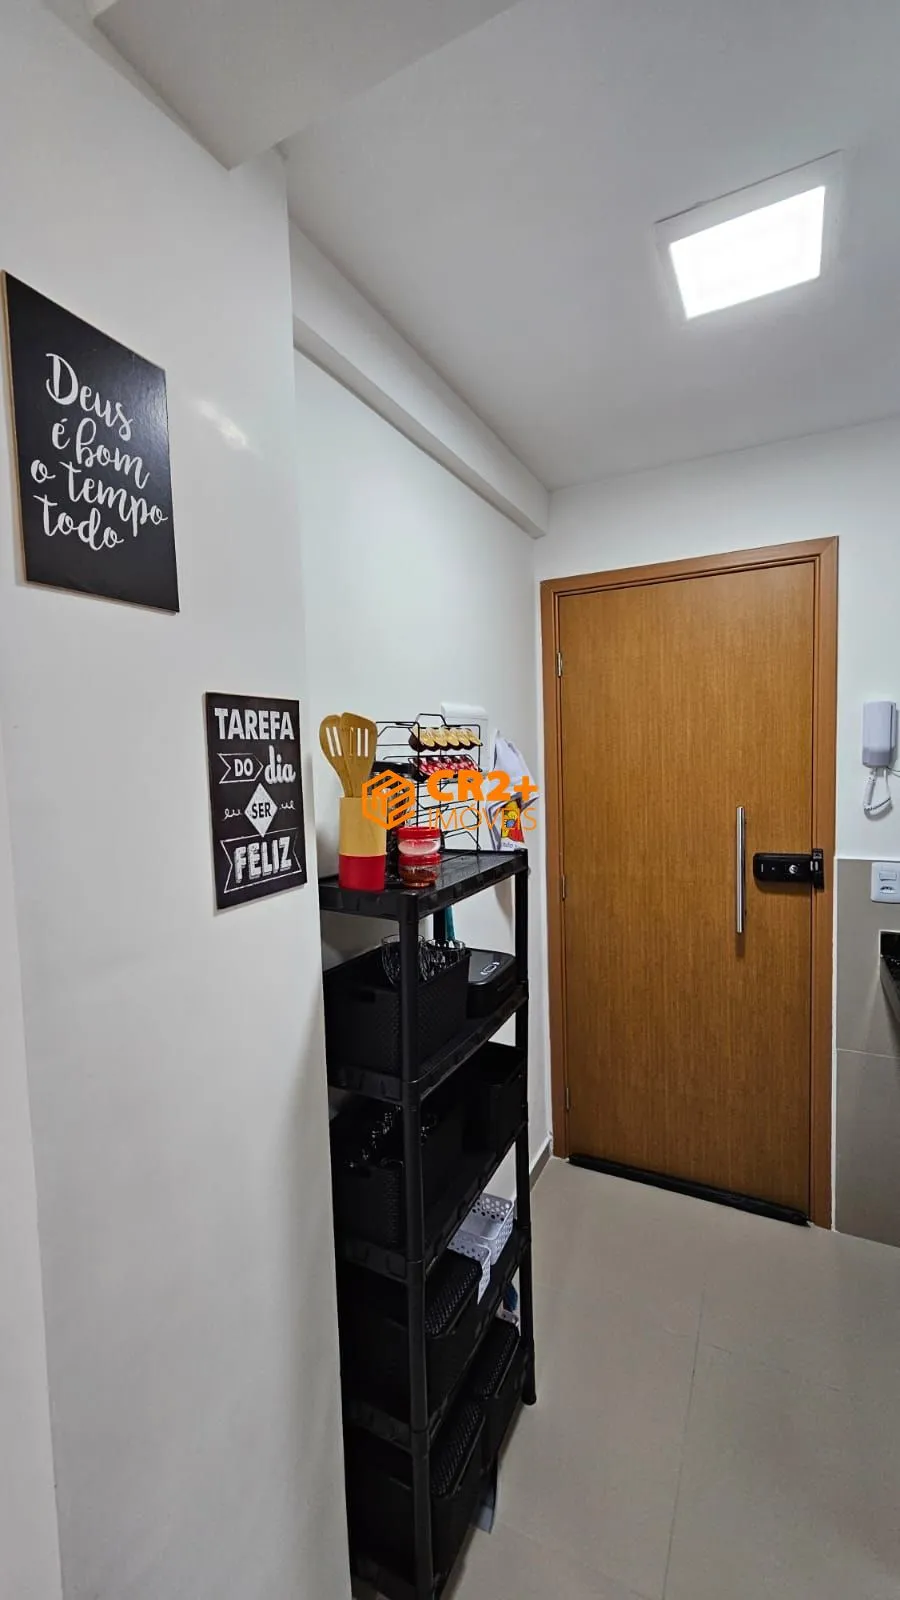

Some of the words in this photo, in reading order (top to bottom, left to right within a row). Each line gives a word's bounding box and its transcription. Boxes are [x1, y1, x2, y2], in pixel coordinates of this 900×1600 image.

[46, 353, 133, 440] Deus
[52, 418, 70, 450] é
[76, 417, 149, 488] bom
[31, 459, 56, 483] o
[60, 461, 168, 537] tempo
[33, 494, 124, 551] todo
[214, 707, 295, 740] TAREFA
[234, 758, 254, 777] DO
[264, 744, 296, 784] dia
[251, 802, 272, 820] SER
[233, 837, 292, 883] FELIZ
